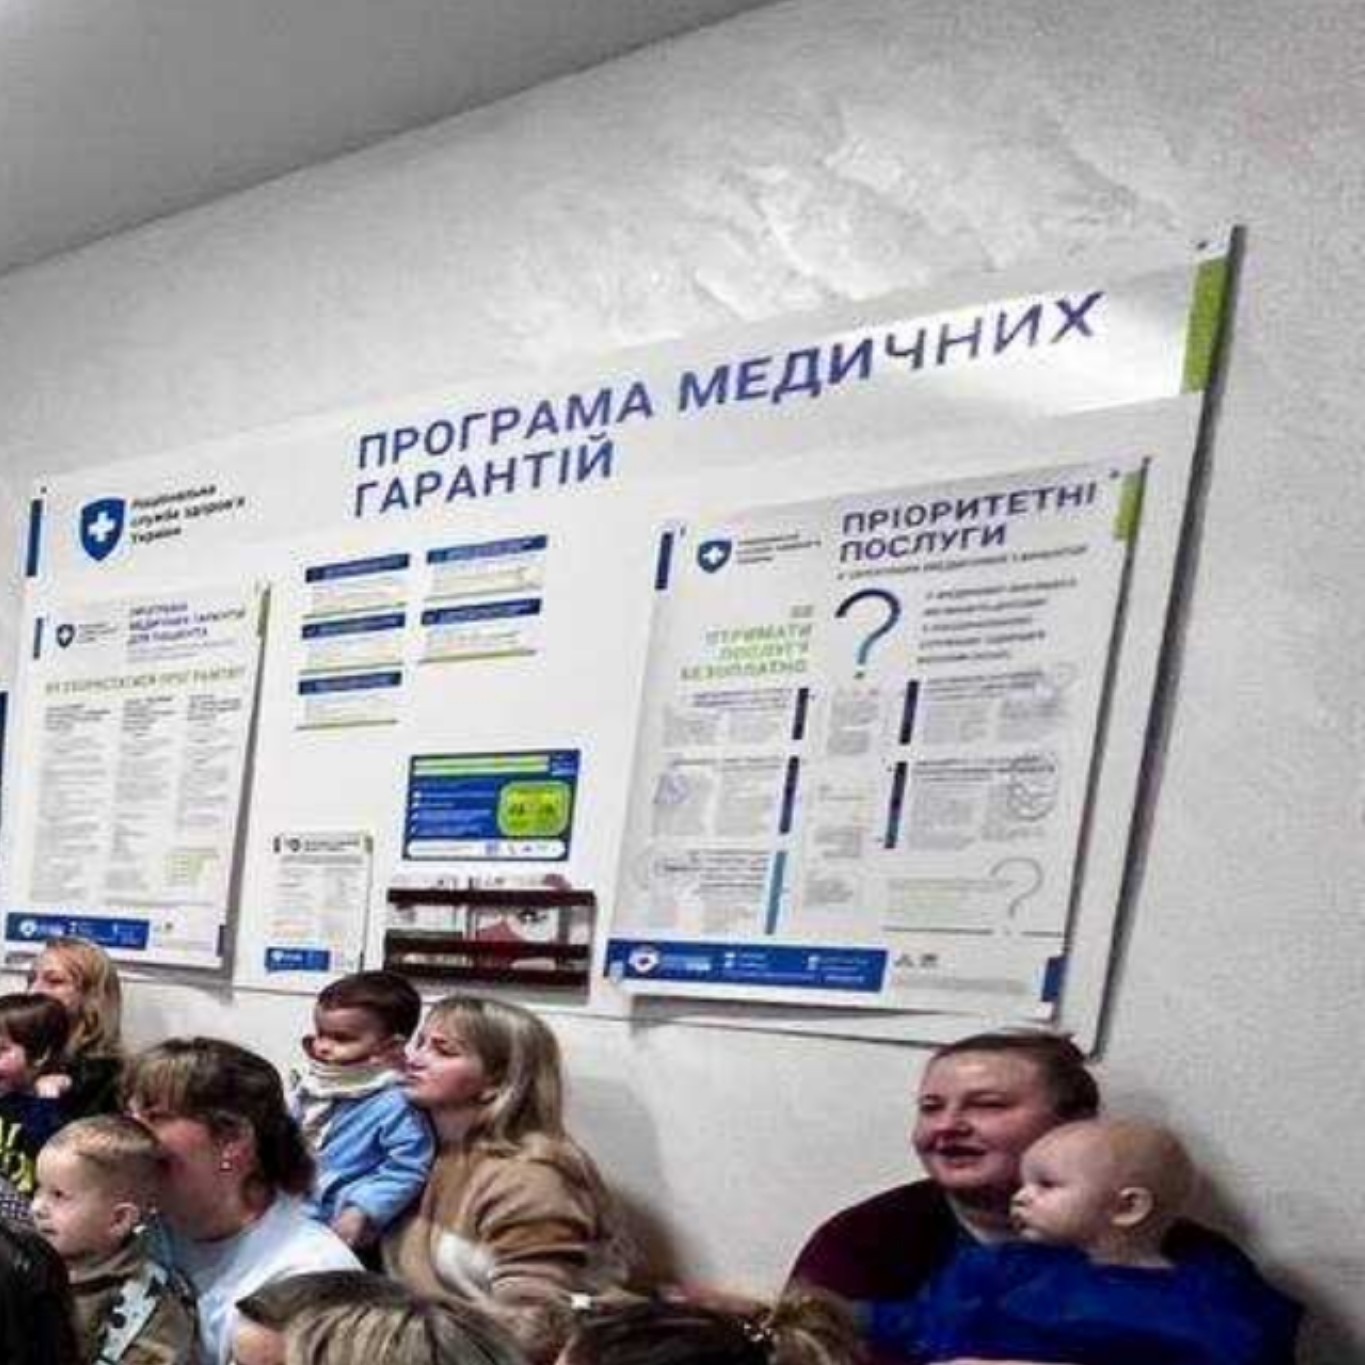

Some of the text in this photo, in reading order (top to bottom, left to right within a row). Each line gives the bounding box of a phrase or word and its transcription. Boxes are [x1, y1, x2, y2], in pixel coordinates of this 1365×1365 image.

[359, 290, 1104, 470] ПРОГРАМА МЕДИЧНИХ
[354, 434, 615, 518] ГАРАНТІЙ
[842, 483, 1097, 535] ПРІОРИТЕТНІ
[839, 524, 1007, 563] ПОСЛУГИ
